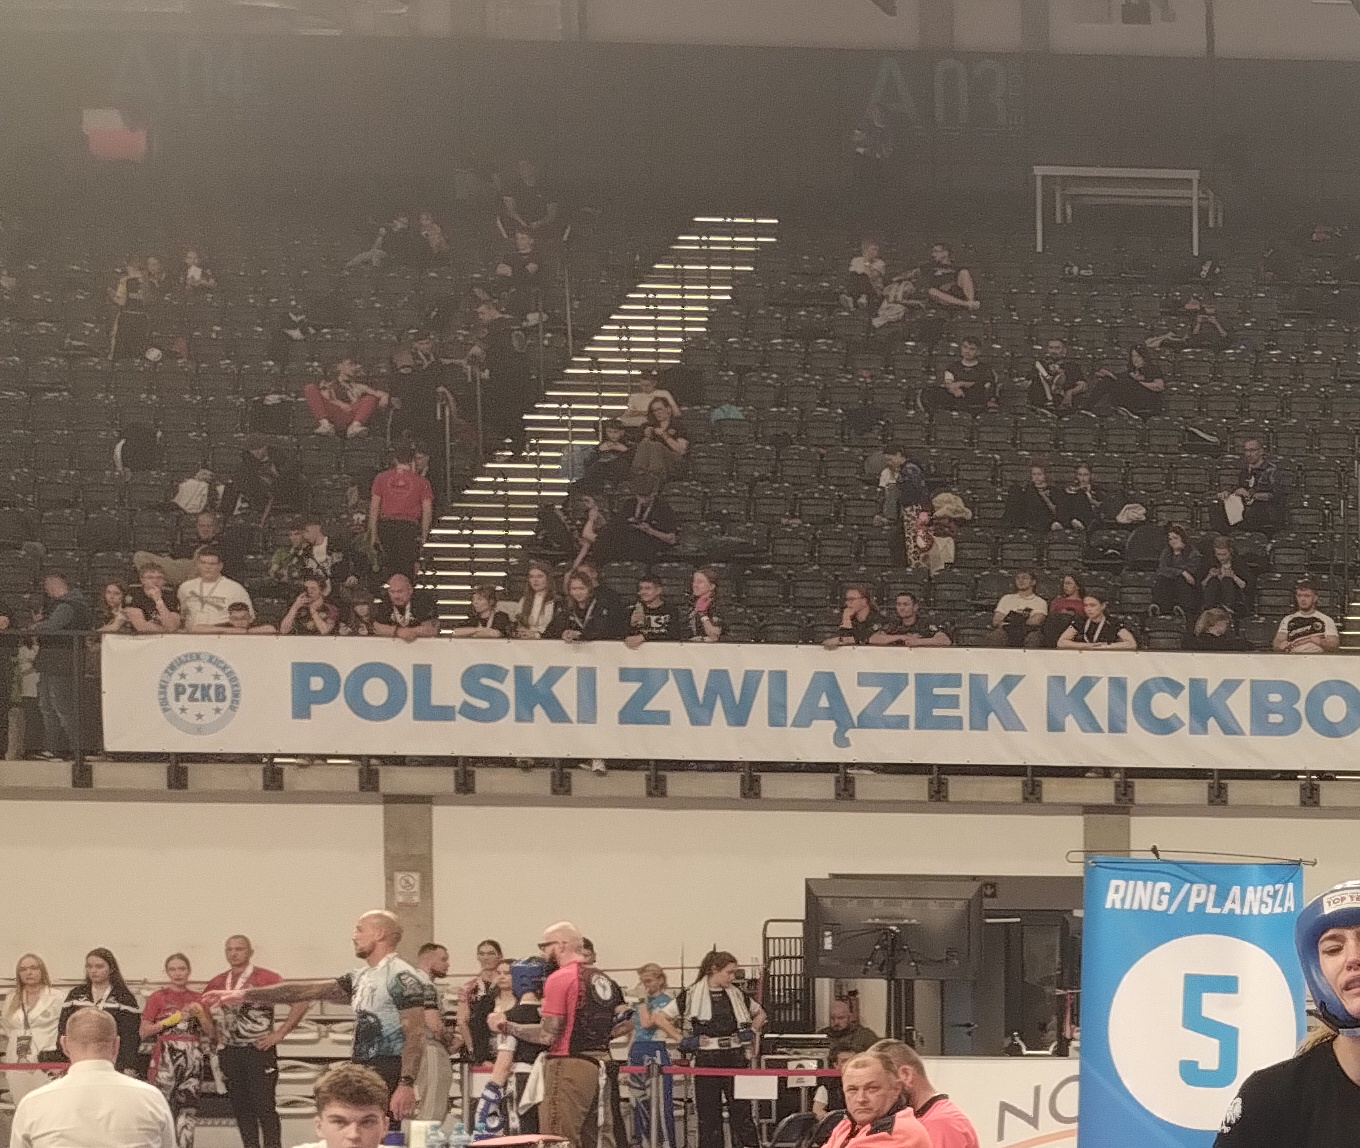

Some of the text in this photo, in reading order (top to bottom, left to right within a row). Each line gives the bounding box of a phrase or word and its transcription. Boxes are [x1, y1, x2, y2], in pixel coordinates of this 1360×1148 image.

[173, 682, 227, 703] PZKB
[291, 661, 597, 724] POLSKI
[618, 667, 1027, 747] ZWIĄZEK
[1104, 878, 1295, 916] RING/PLANSZA
[1178, 972, 1240, 1089] 5
